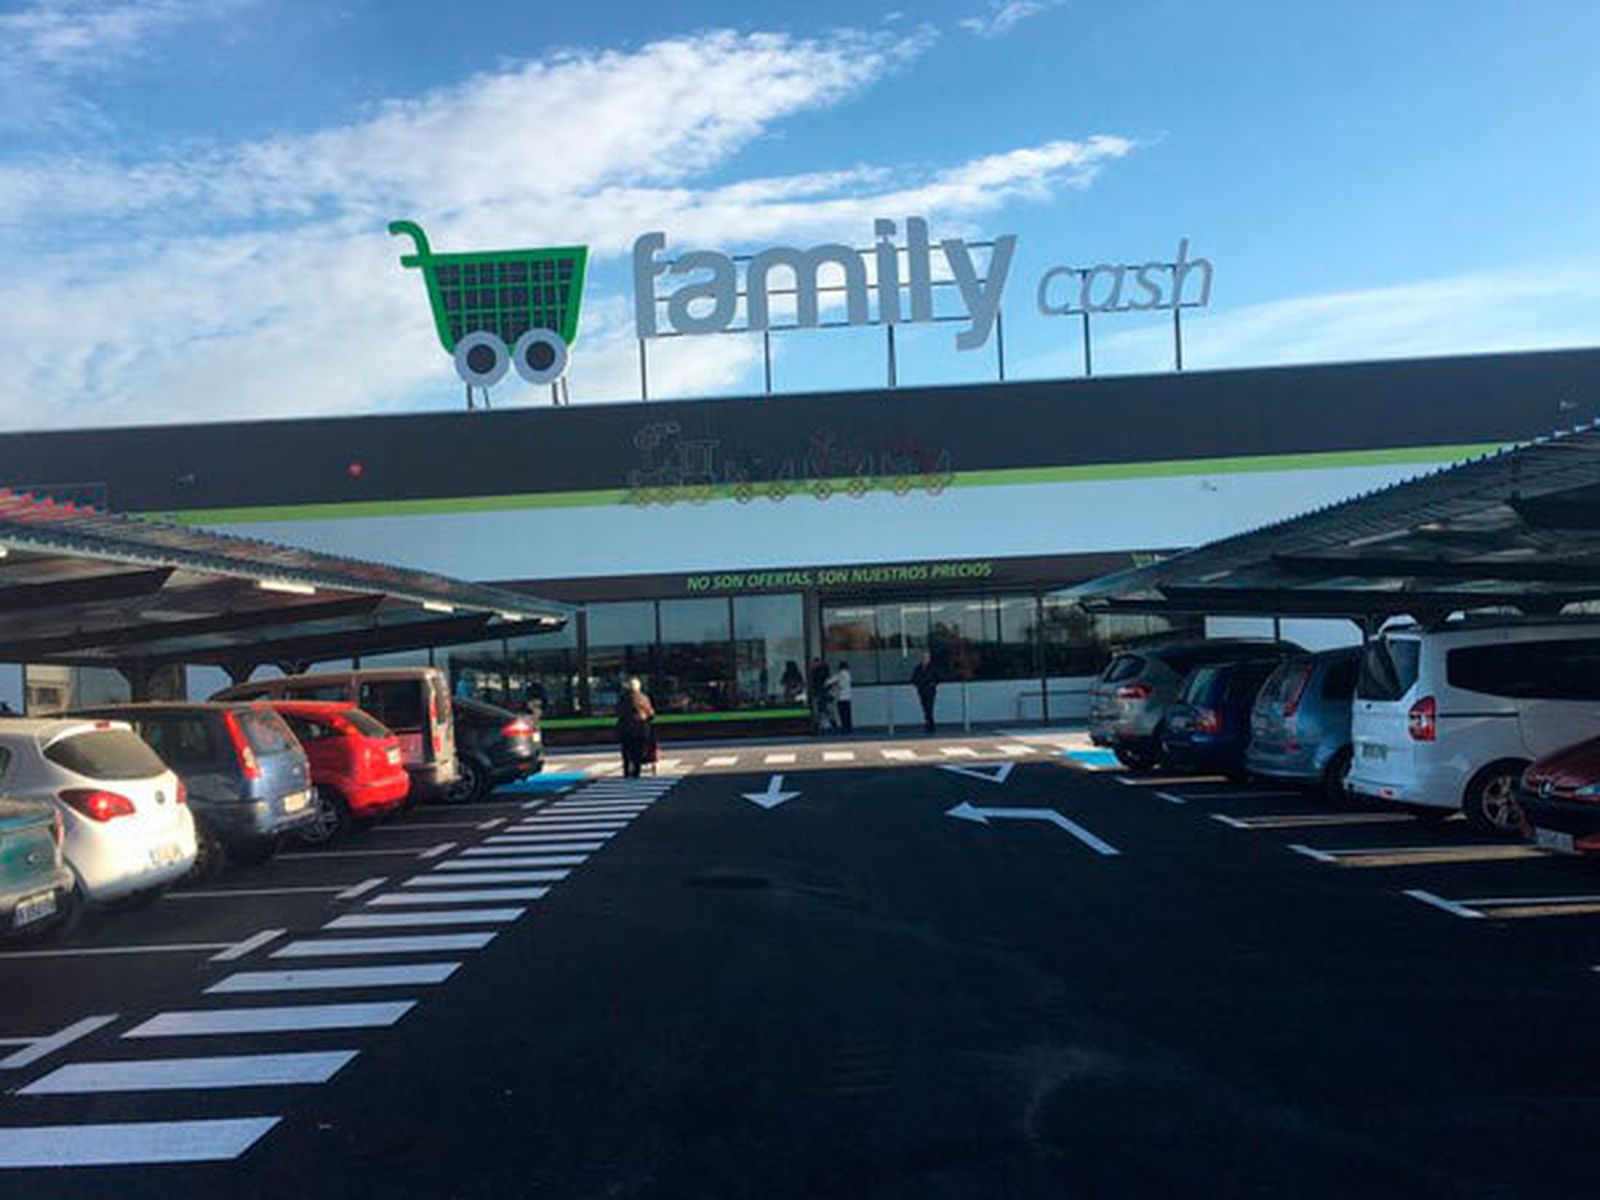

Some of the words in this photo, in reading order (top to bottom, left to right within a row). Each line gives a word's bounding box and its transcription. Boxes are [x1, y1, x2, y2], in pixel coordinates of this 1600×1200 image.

[633, 216, 1017, 350] family
[1037, 238, 1213, 315] cash
[687, 575, 710, 591] NO
[712, 574, 744, 590] SON
[817, 568, 848, 585] SON
[851, 565, 928, 582] NUESTROS
[931, 562, 993, 578] PRECIOS
